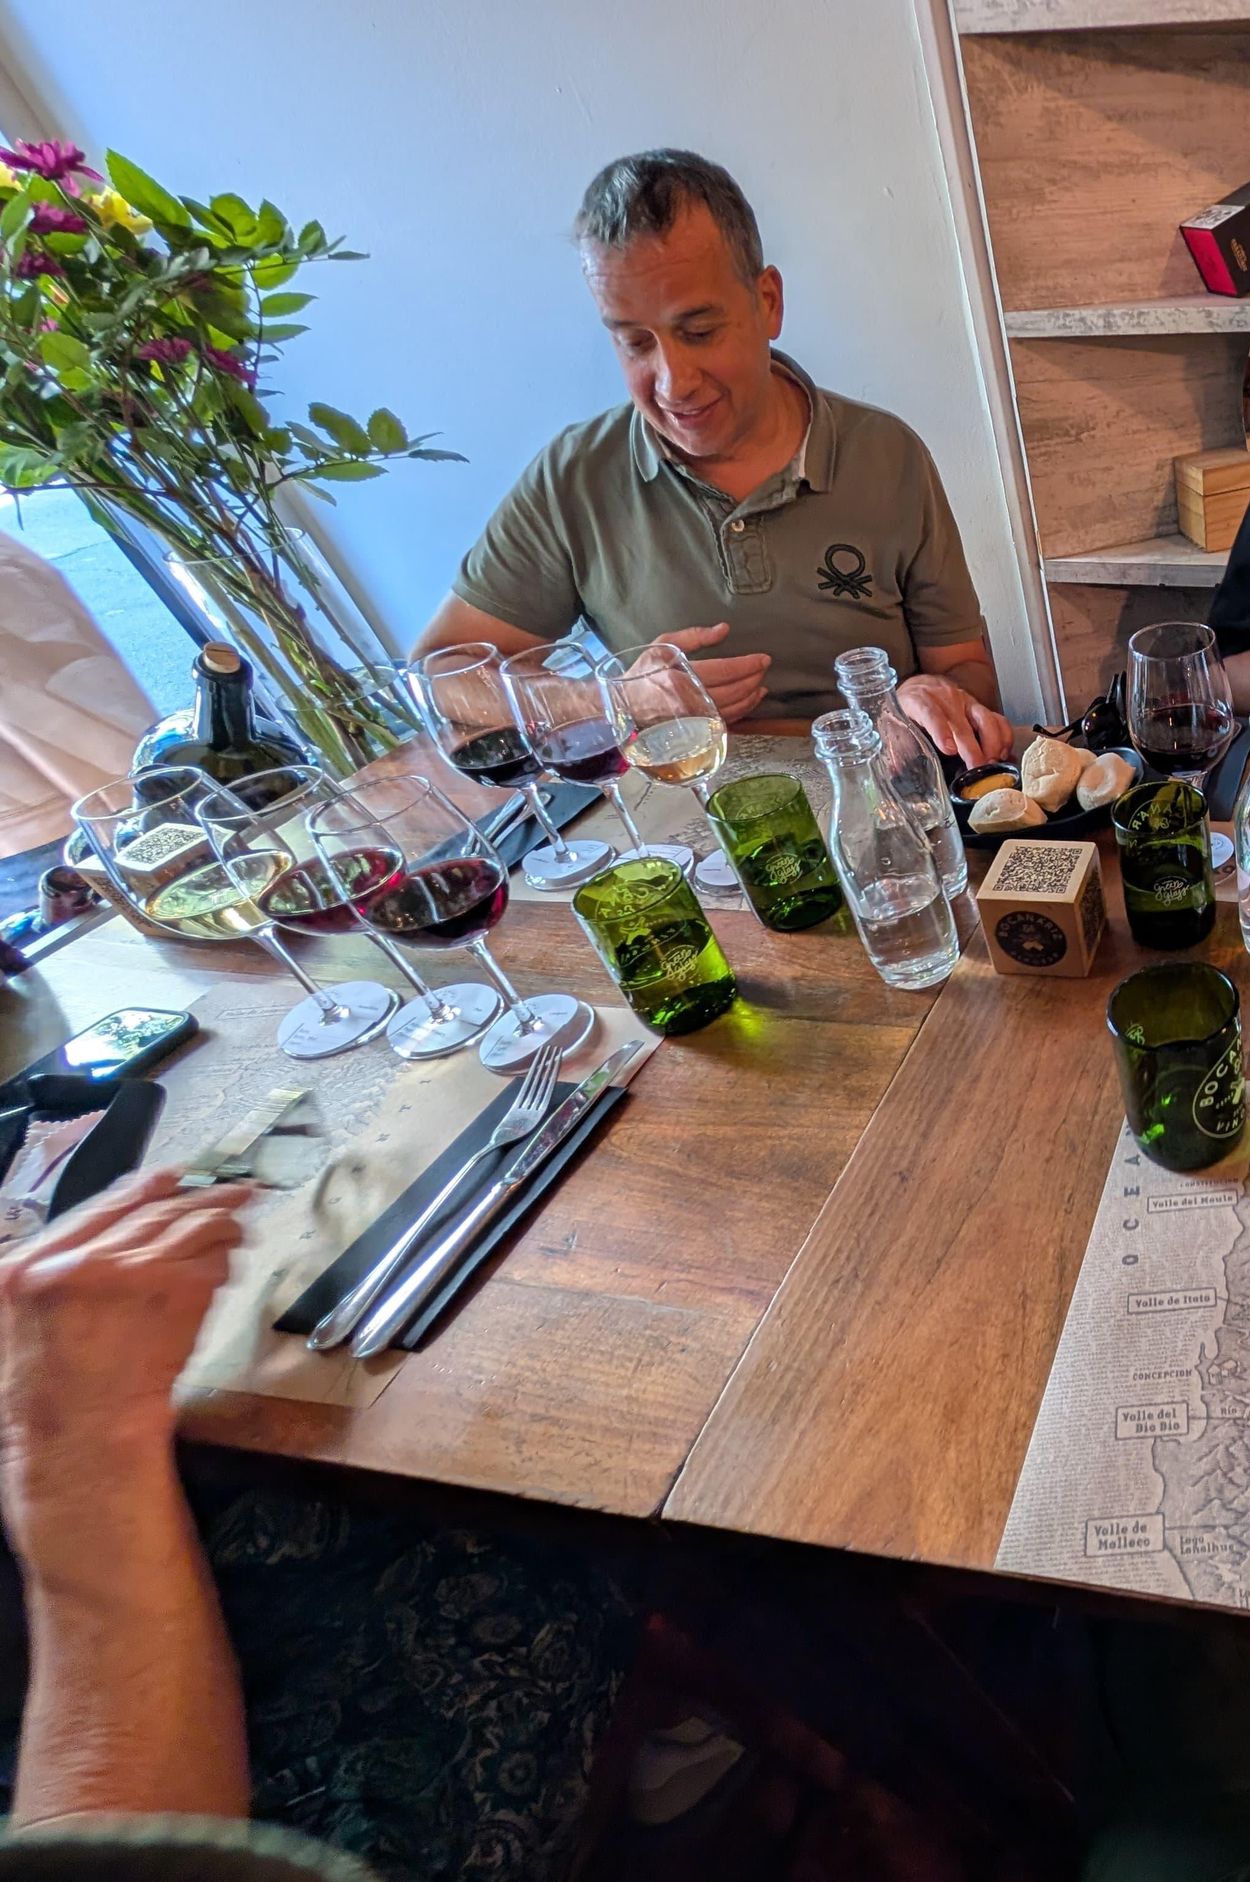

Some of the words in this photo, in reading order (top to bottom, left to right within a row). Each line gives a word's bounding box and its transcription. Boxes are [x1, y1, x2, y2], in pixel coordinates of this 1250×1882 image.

[1152, 1197, 1179, 1209] Valle
[1134, 1297, 1163, 1309] Valle
[1166, 1295, 1181, 1306] de
[1122, 1411, 1154, 1422] Valle
[1157, 1407, 1178, 1420] del
[1094, 1523, 1129, 1537] Valle
[1131, 1521, 1148, 1534] de
